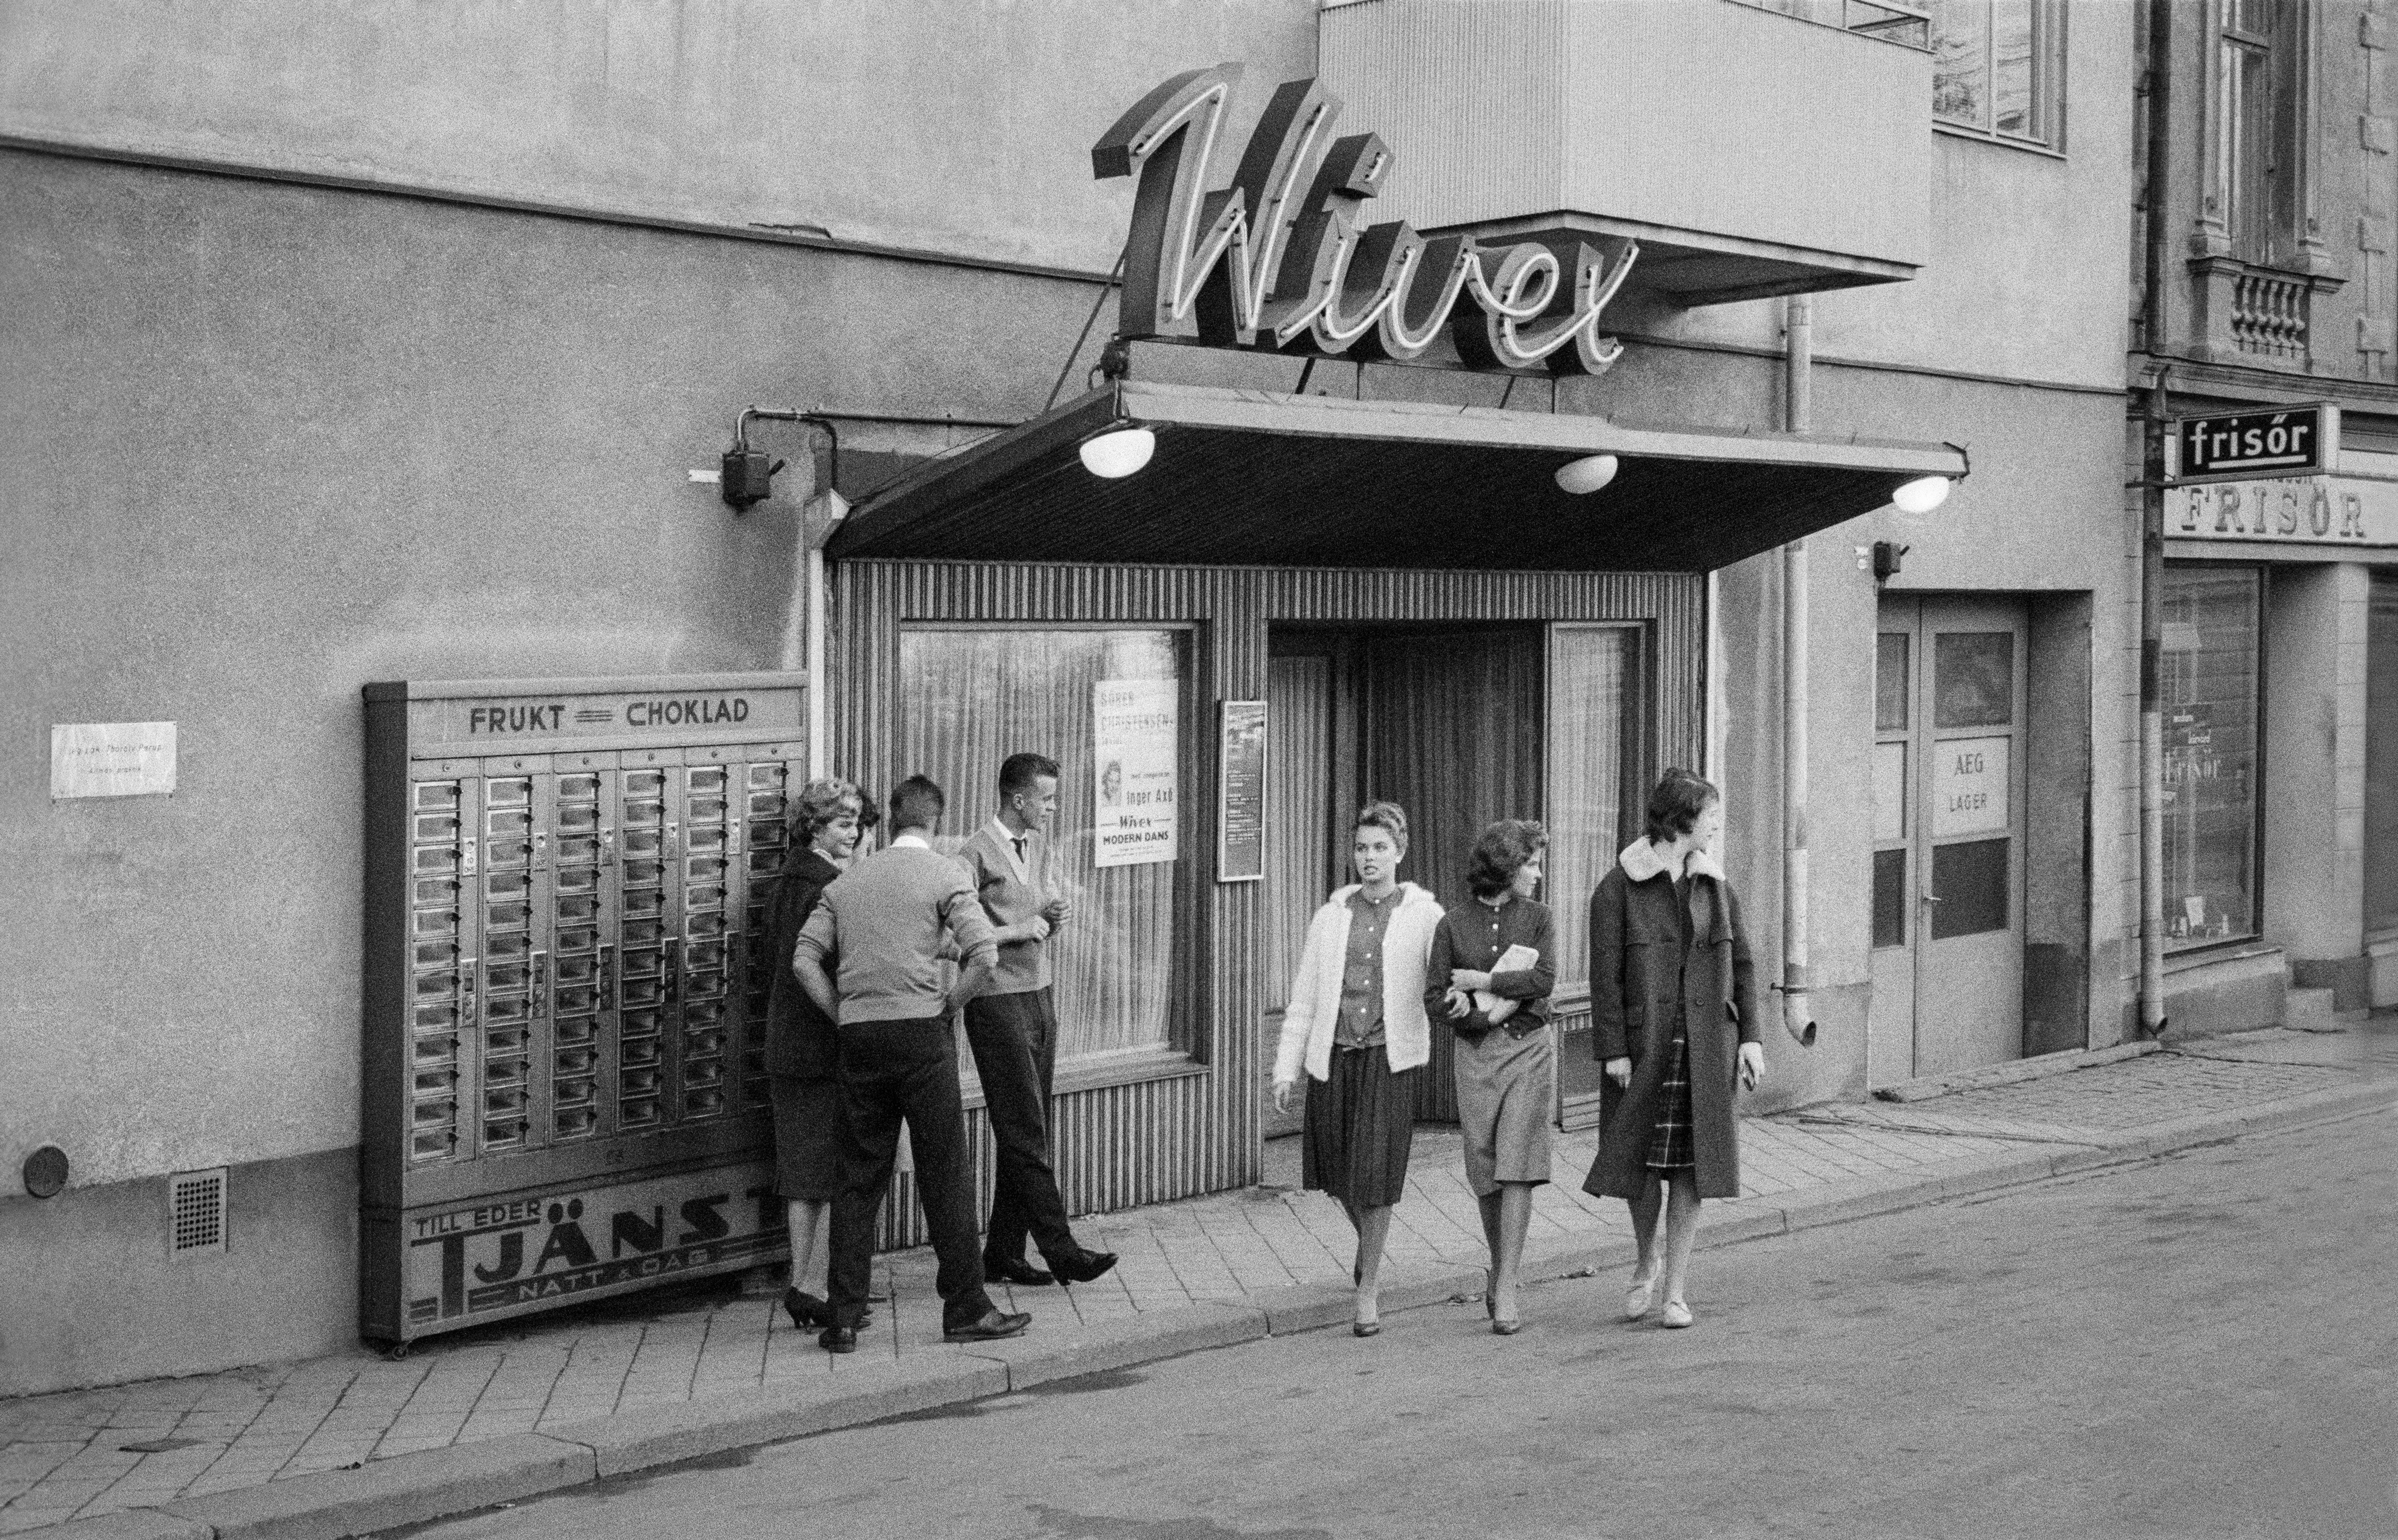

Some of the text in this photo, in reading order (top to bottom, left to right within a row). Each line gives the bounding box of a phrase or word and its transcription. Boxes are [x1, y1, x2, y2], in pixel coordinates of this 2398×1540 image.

[1092, 62, 1639, 375] Wivex
[2190, 413, 2308, 465] frisör
[2181, 483, 2366, 538] FRISÖR
[470, 698, 749, 734] FRUKT CHOKLAD
[1954, 752, 1983, 777] AEG
[1950, 793, 1987, 812] LAGER
[1103, 831, 1169, 845] MODERN DANS
[415, 1199, 541, 1236] TILL EDER
[411, 1185, 784, 1318] TJÄNST
[518, 1269, 604, 1300] NATT
